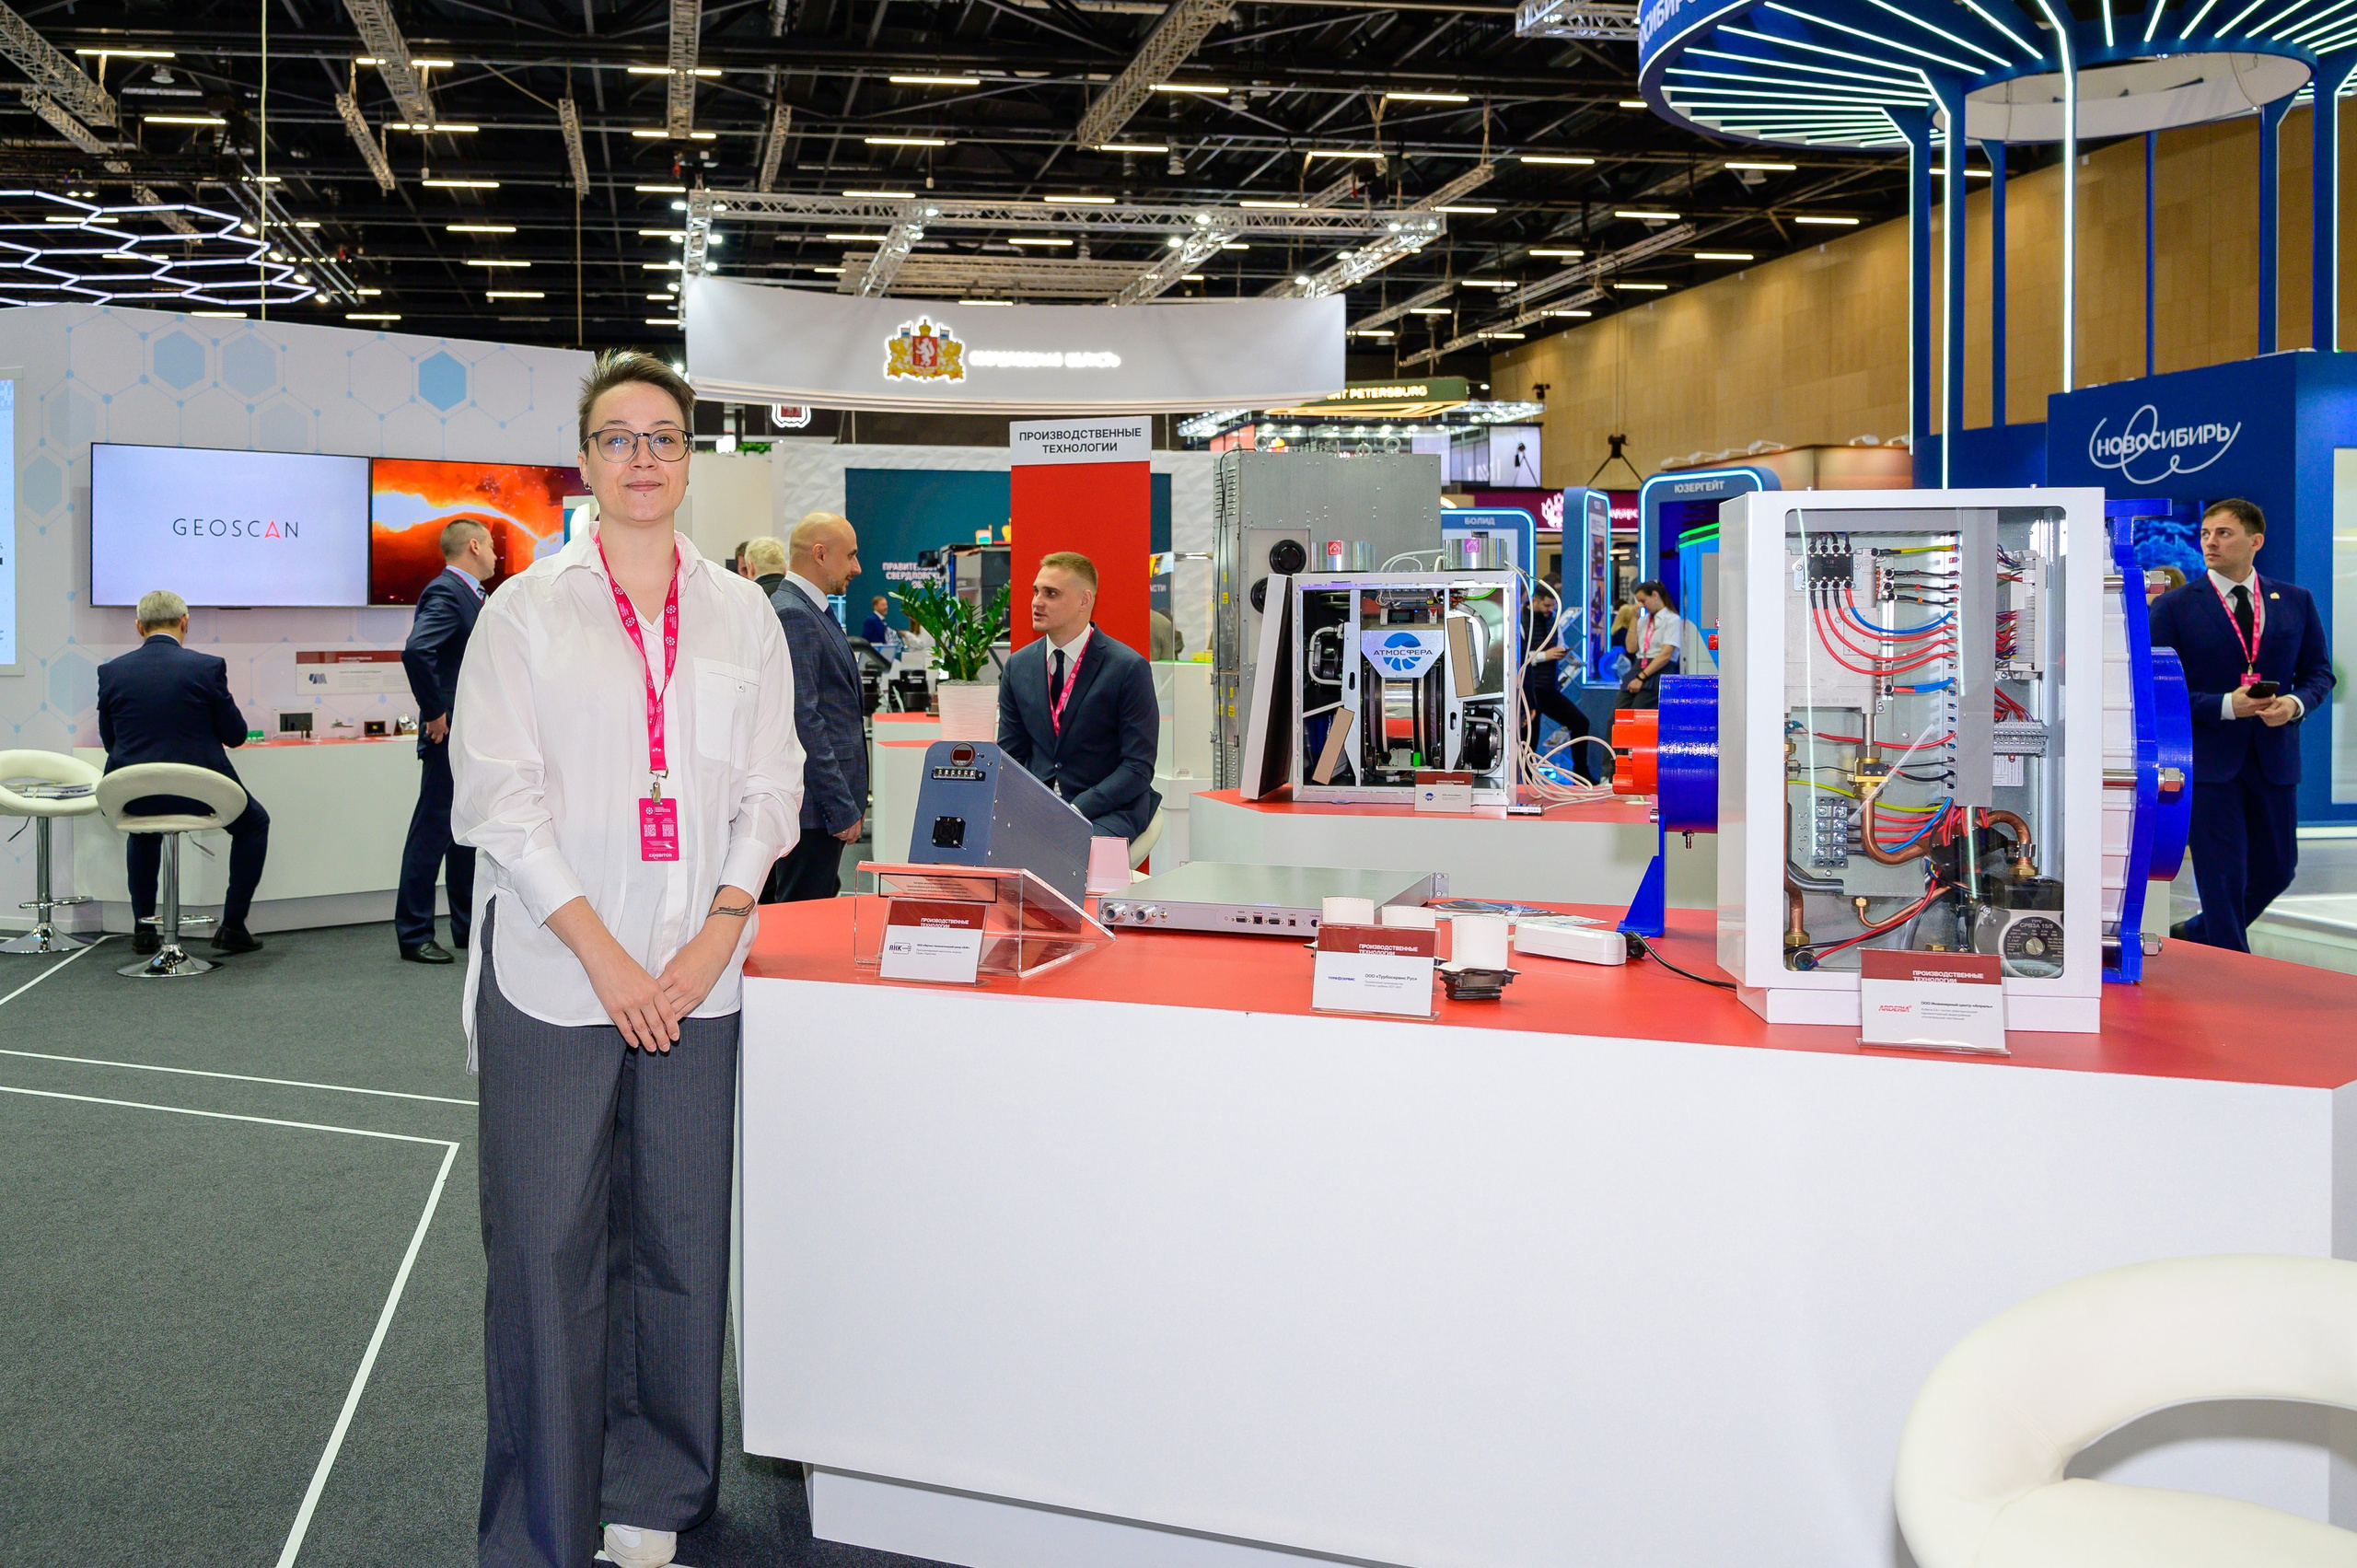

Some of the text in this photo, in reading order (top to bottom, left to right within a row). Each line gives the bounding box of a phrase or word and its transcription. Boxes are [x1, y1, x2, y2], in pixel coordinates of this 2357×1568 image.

[1350, 385, 1428, 400] PETERSBURG
[1019, 427, 1142, 441] ПРОИЗВОДСТВЕННЫЕ
[1042, 442, 1118, 454] ТЕХНОЛОГИИ
[1674, 480, 1725, 494] ЮЗЕРГЕЙТ
[1464, 517, 1496, 526] БОЛИД
[172, 517, 299, 540] GEOSCAN
[1358, 943, 1419, 952] ПРОИЗВОДСТВЕННЫЕ
[1912, 970, 1984, 980] ПРОИЗВОДСТВЕННЫЕ
